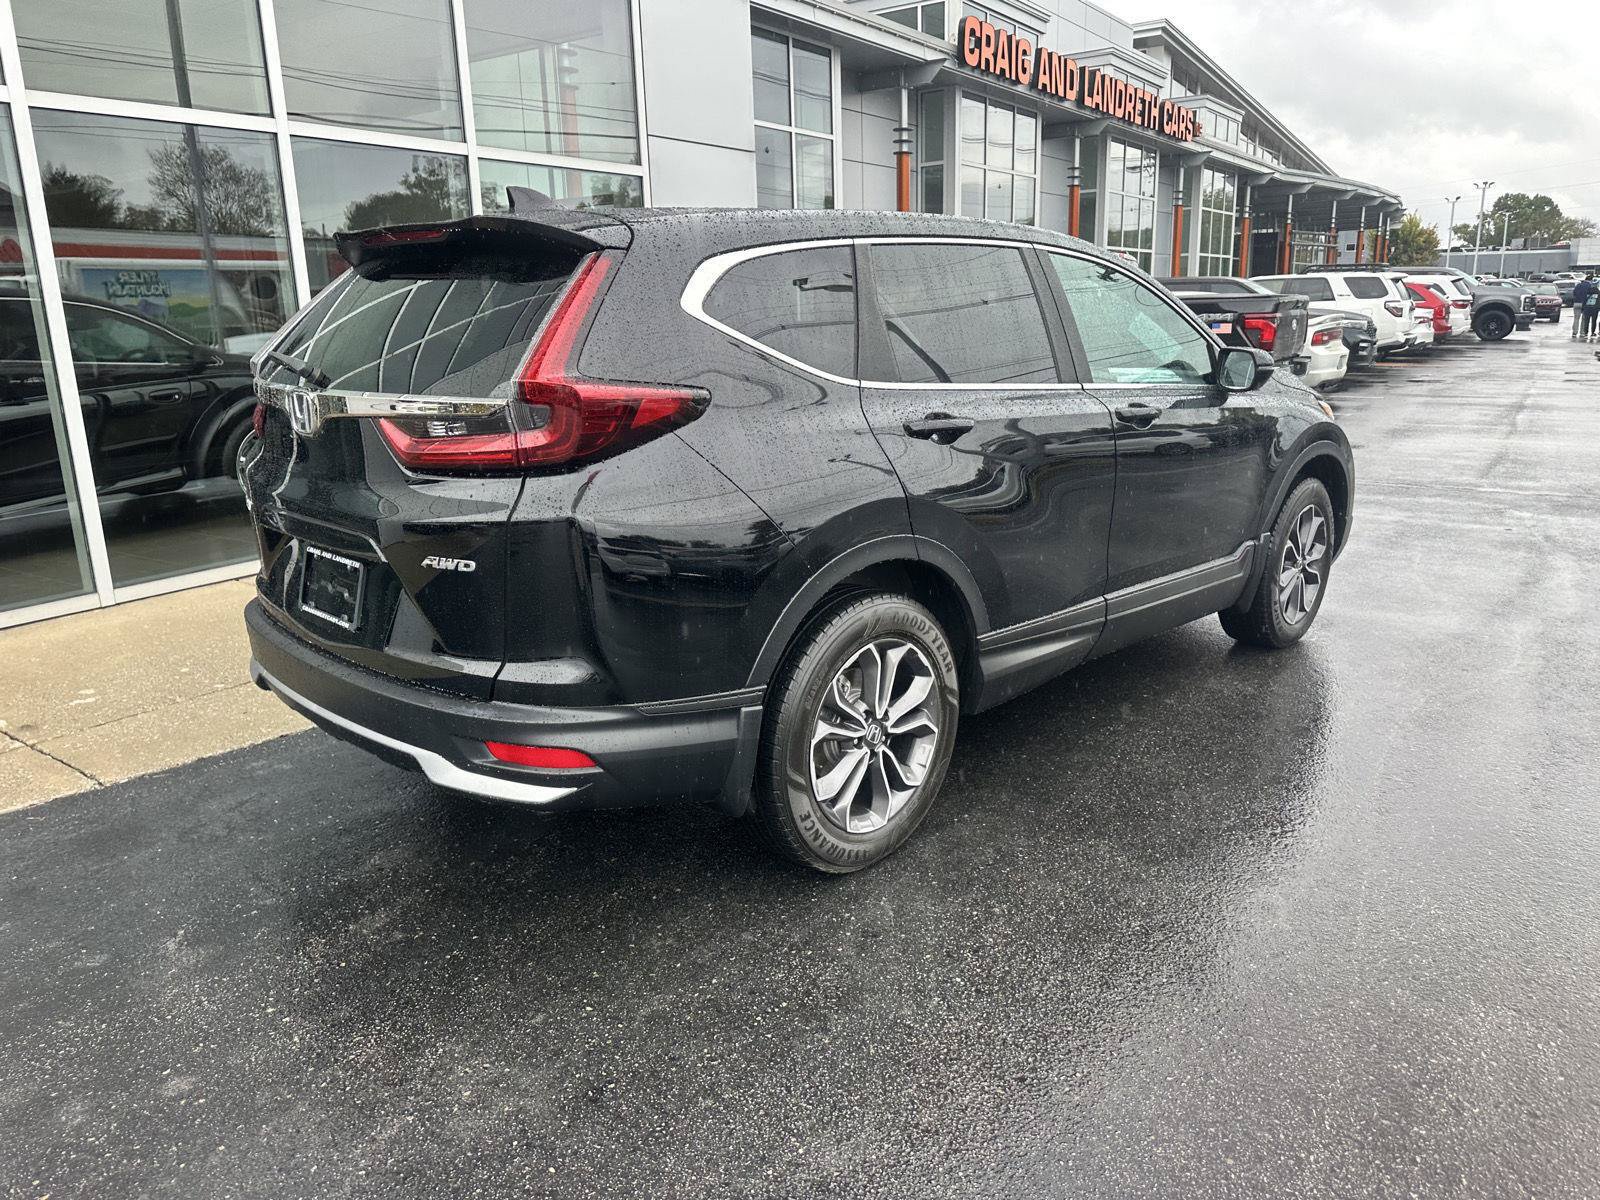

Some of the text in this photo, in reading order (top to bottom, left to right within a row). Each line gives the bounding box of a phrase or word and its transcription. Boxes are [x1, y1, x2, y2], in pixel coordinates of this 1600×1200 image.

[960, 15, 1195, 144] CRAIG AND LANDRETH CARS
[420, 555, 477, 573] AWD
[893, 610, 954, 674] GOODYEAR
